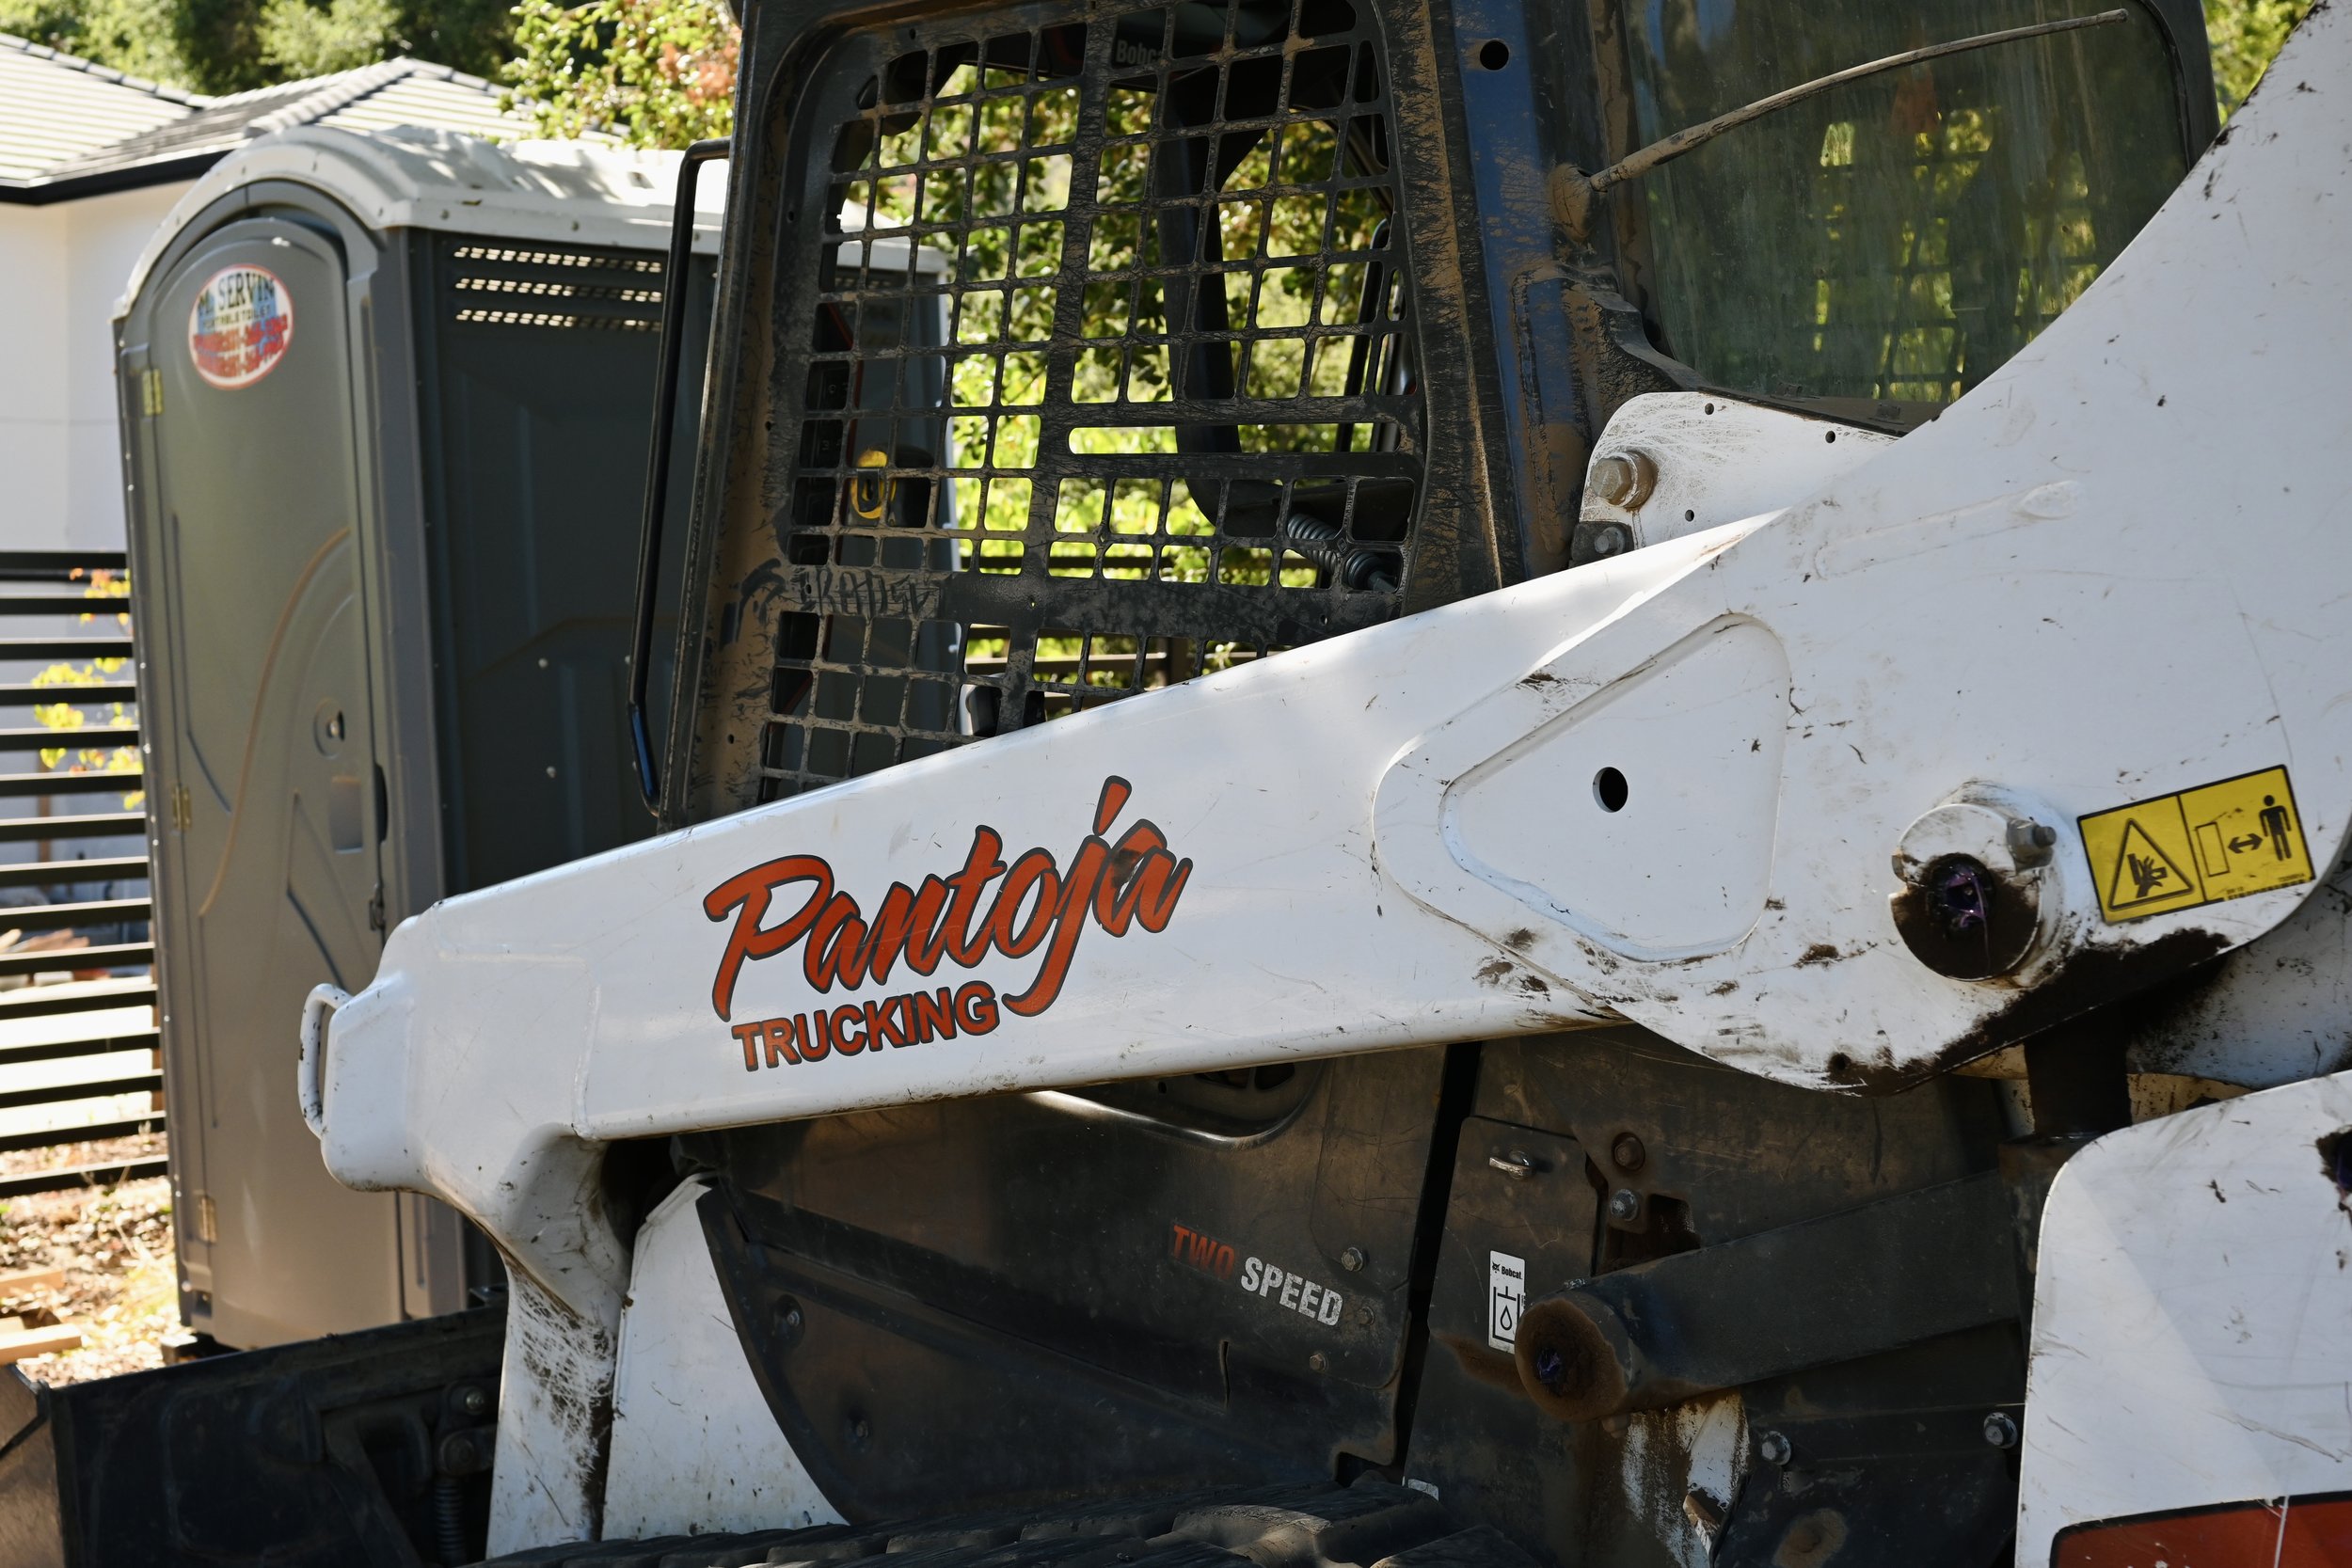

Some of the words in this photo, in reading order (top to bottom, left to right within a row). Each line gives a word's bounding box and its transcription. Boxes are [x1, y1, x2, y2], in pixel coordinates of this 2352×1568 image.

[704, 775, 1193, 1022] Pantoja
[731, 980, 1001, 1071] TRUCKING
[1173, 1225, 1235, 1280] TWO
[1241, 1257, 1343, 1326] SPEED
[1502, 1266, 1522, 1279] Bobcat
